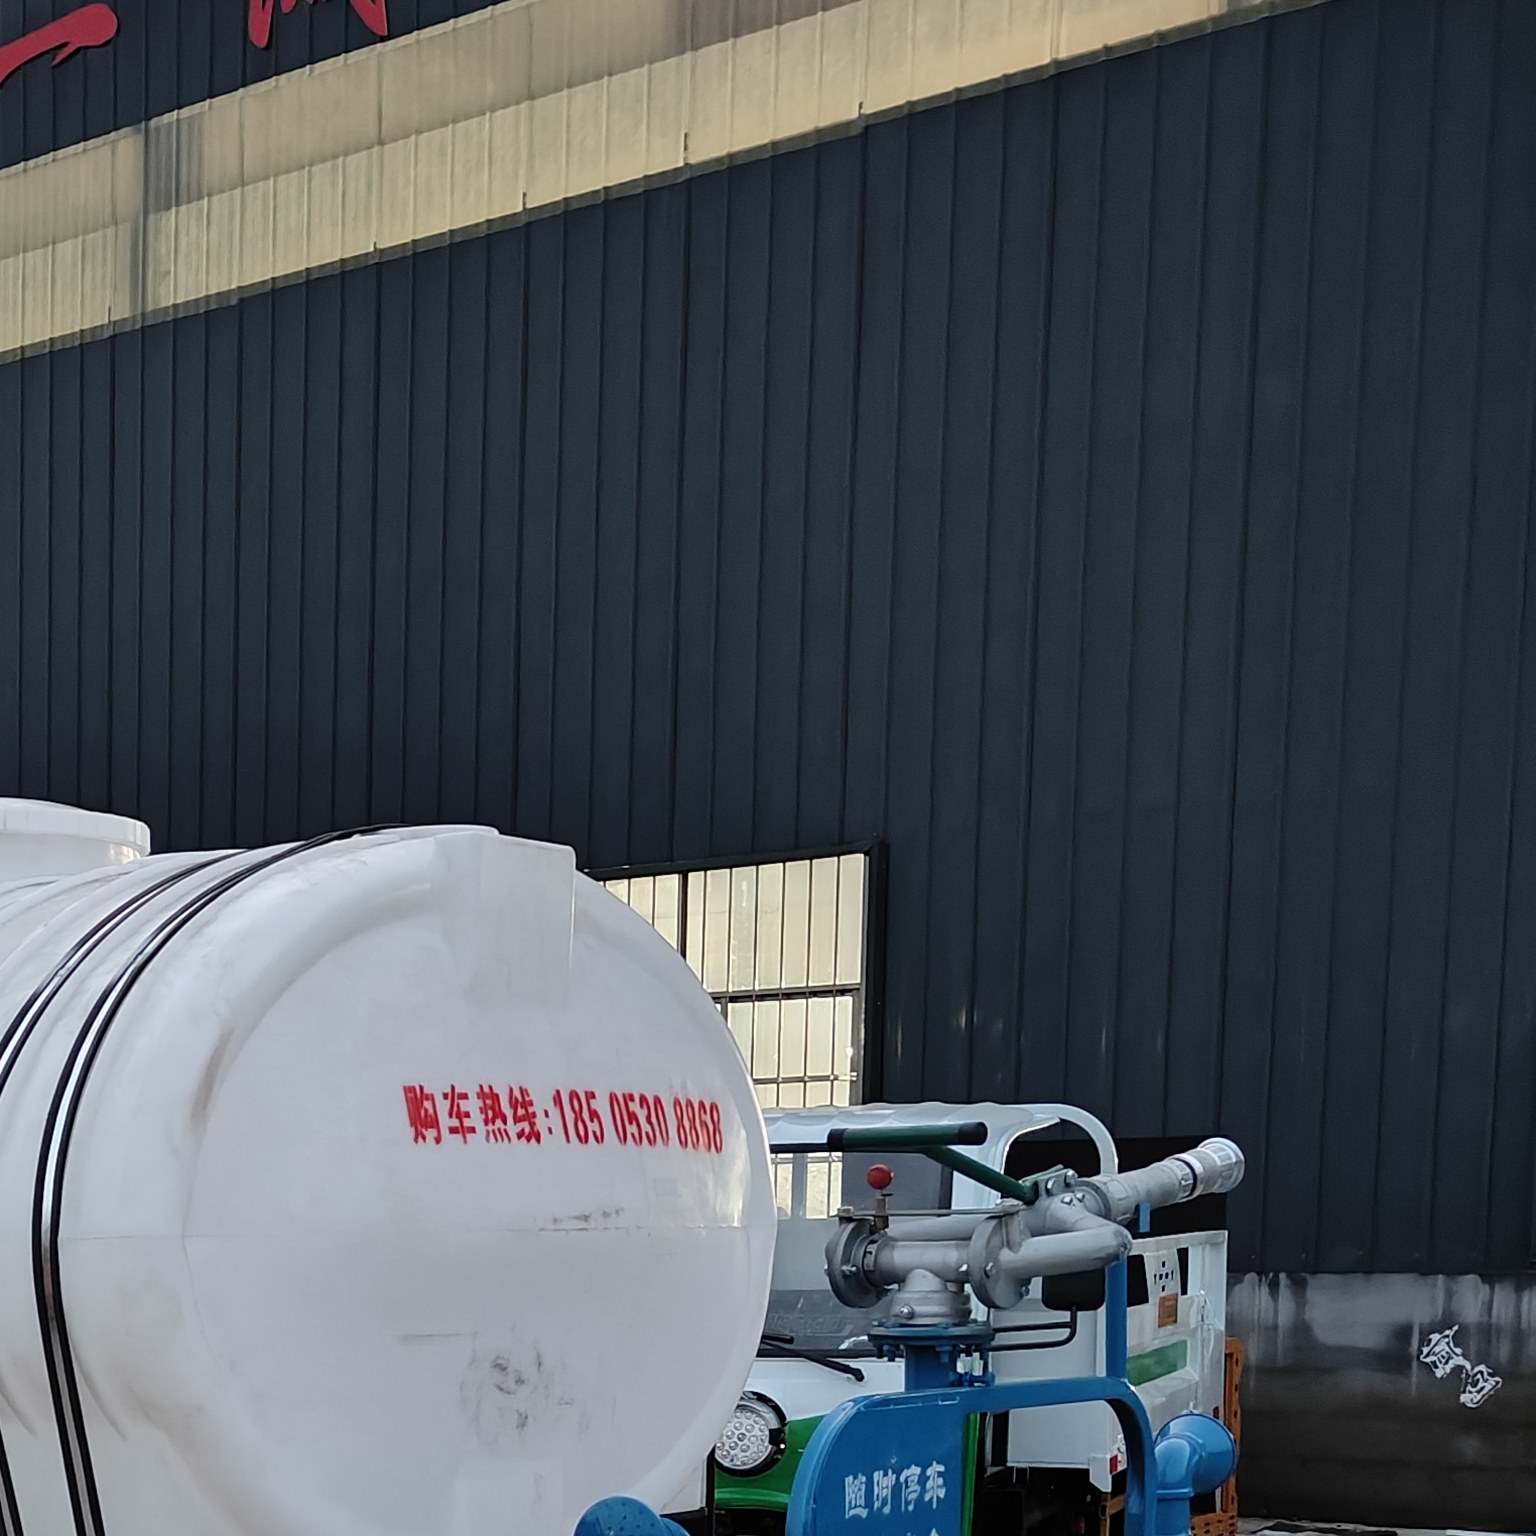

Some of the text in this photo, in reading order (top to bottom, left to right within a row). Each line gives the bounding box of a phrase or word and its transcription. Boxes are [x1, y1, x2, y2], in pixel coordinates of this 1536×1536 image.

[608, 1090, 670, 1147] 0530
[672, 1096, 724, 1154] 8868
[844, 1460, 946, 1519] 随时停车
